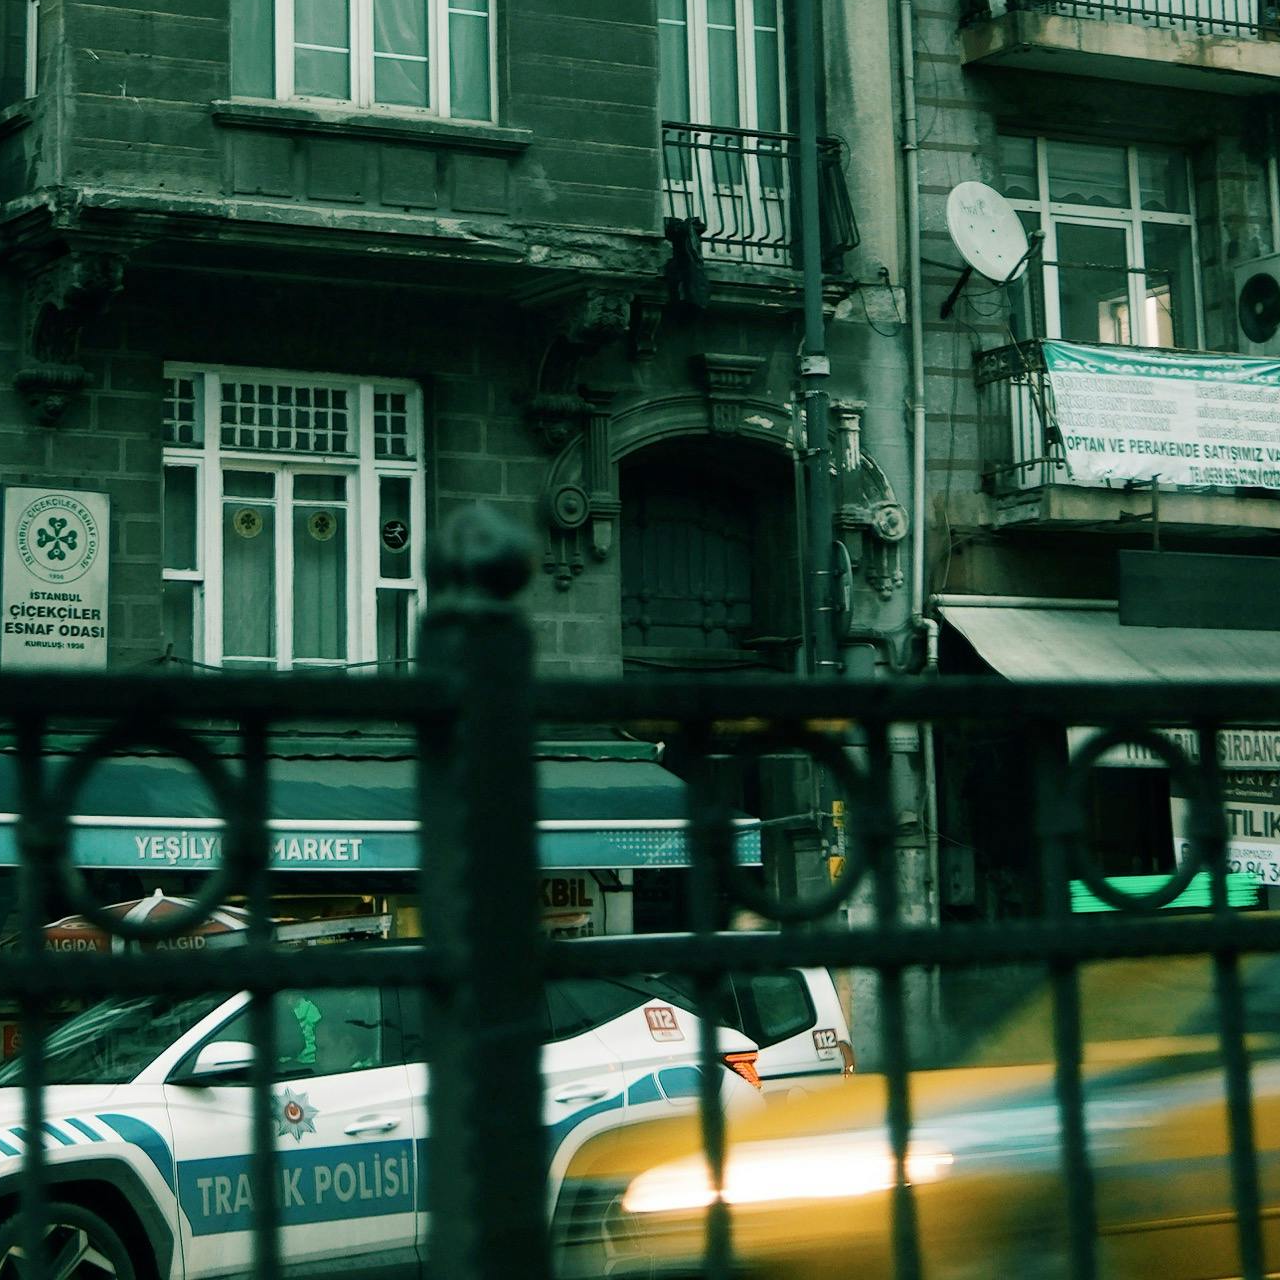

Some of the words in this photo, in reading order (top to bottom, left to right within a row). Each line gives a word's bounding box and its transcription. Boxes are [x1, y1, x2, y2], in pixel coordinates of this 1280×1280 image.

[1065, 436, 1106, 454] OPTAN
[1109, 438, 1125, 453] VE
[1129, 440, 1201, 459] PERAKENDE
[30, 589, 83, 603] İSTANBUL
[9, 601, 101, 623] ÇİÇEKÇİLER
[4, 622, 55, 636] ESNAF
[59, 624, 105, 639] ODASI
[648, 1010, 676, 1028] 112
[815, 1030, 837, 1048] 112
[196, 1168, 305, 1217] TRAK
[314, 1150, 410, 1205] POLİSİ
